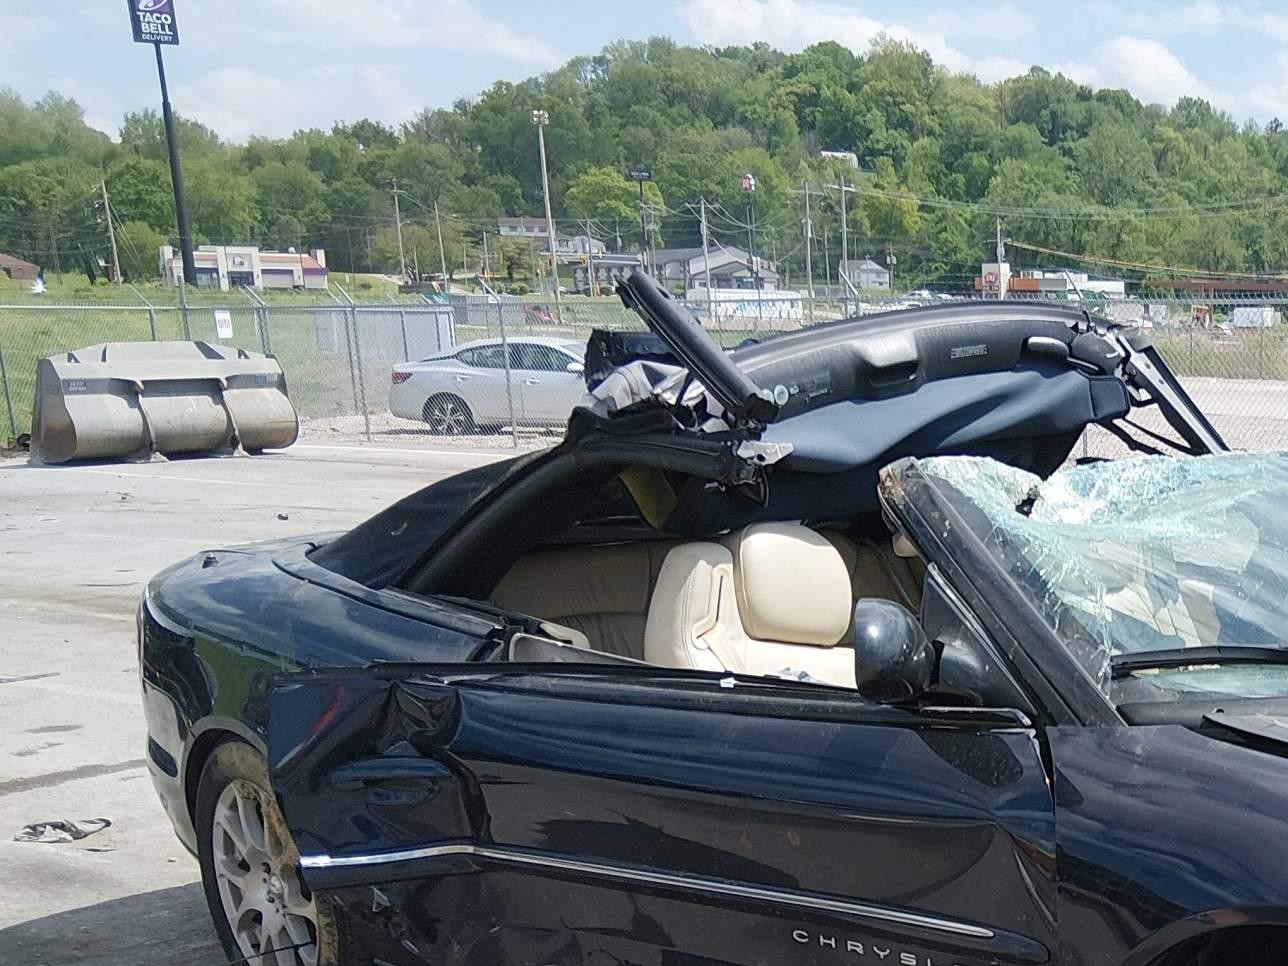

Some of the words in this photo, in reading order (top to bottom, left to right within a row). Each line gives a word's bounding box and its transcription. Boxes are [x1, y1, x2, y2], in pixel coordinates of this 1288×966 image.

[137, 11, 172, 25] TACO
[141, 22, 174, 35] BELL
[142, 33, 173, 42] DELIVERY
